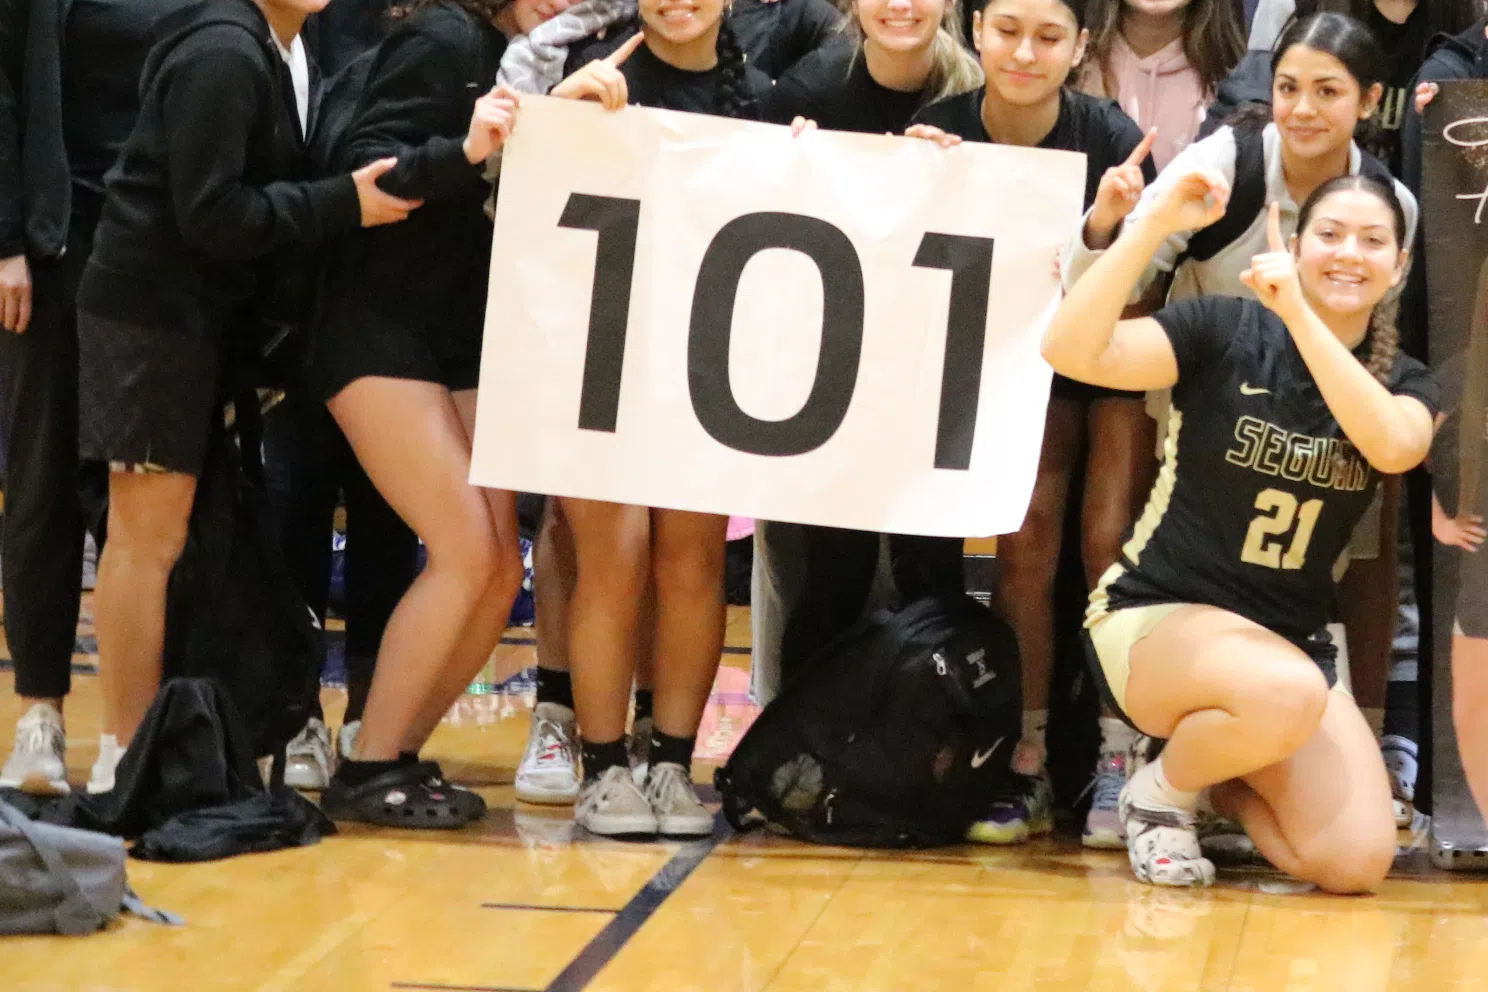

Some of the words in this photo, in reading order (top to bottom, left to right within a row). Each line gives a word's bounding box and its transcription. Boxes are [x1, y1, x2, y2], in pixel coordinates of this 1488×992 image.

[557, 192, 995, 471] 101
[1224, 414, 1371, 492] SEGUIN
[1240, 487, 1325, 571] 21
